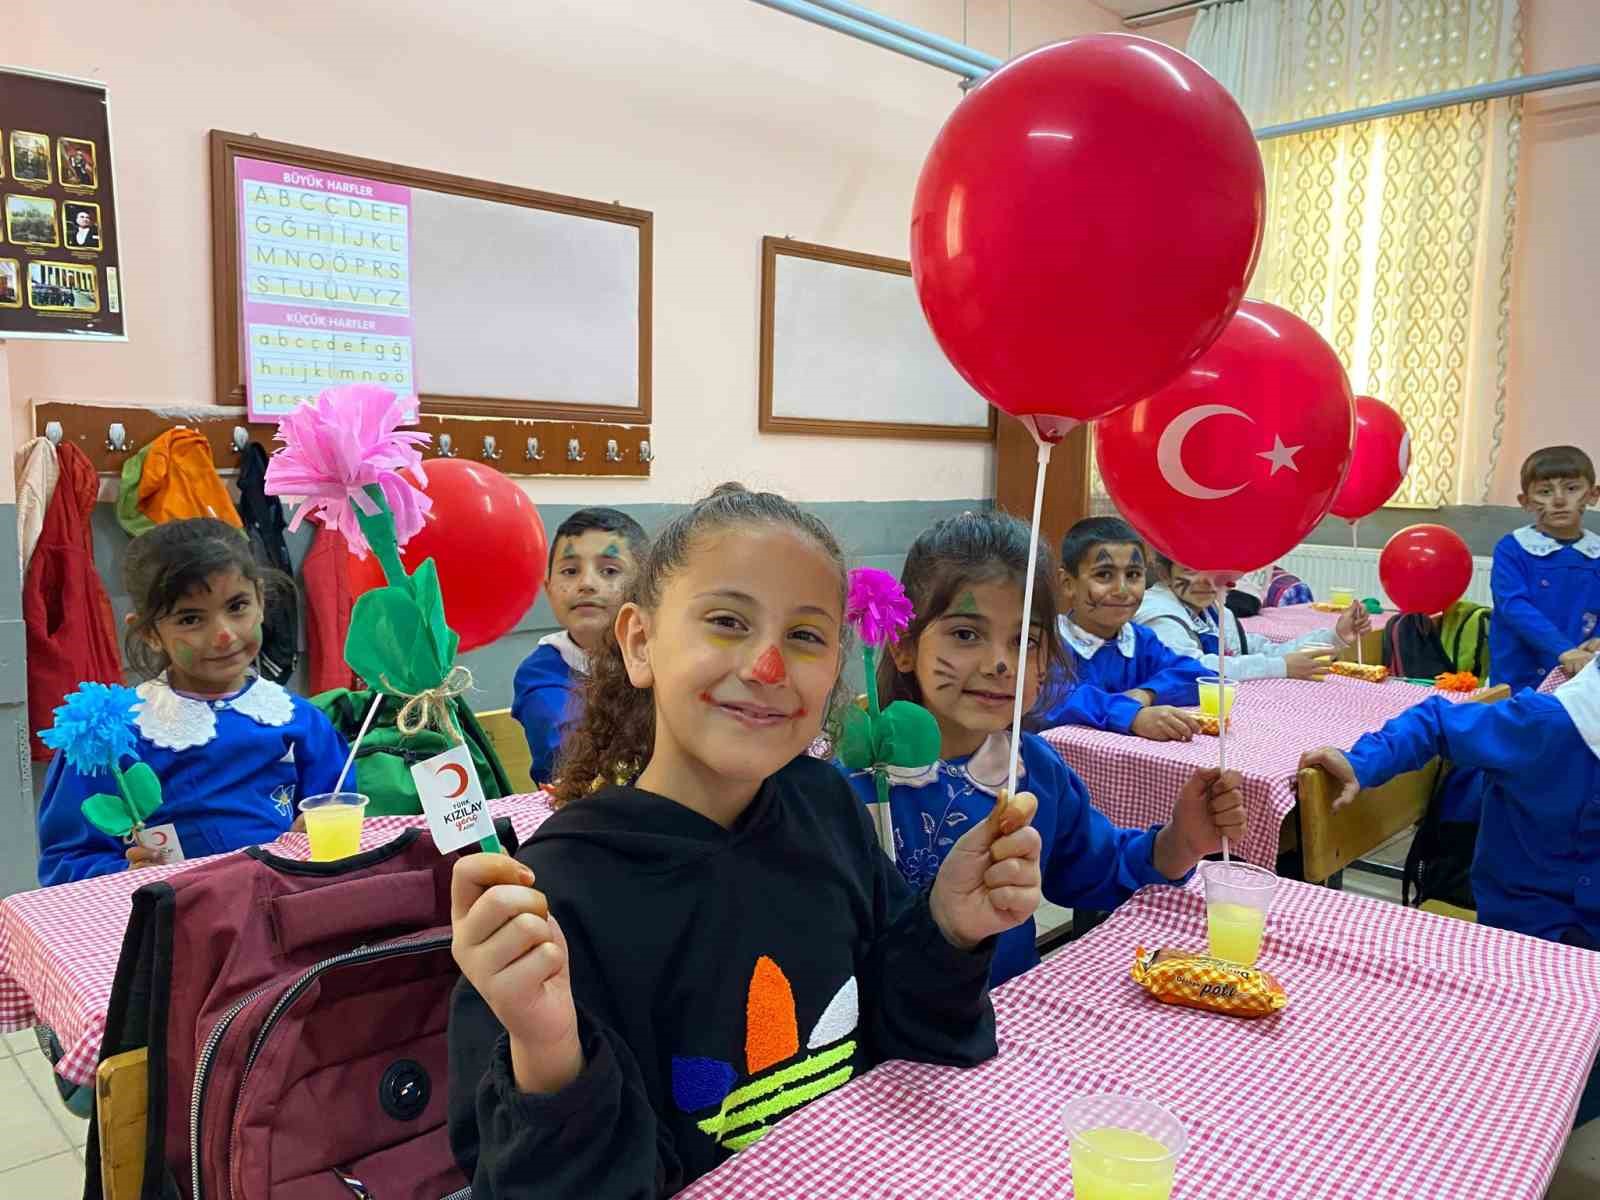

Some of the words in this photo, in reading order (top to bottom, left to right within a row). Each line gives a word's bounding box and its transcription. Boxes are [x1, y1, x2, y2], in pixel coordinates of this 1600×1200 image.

[283, 172, 324, 188] BÜYÜK
[327, 179, 373, 196] HARFLER
[444, 800, 482, 825] KIZILAY
